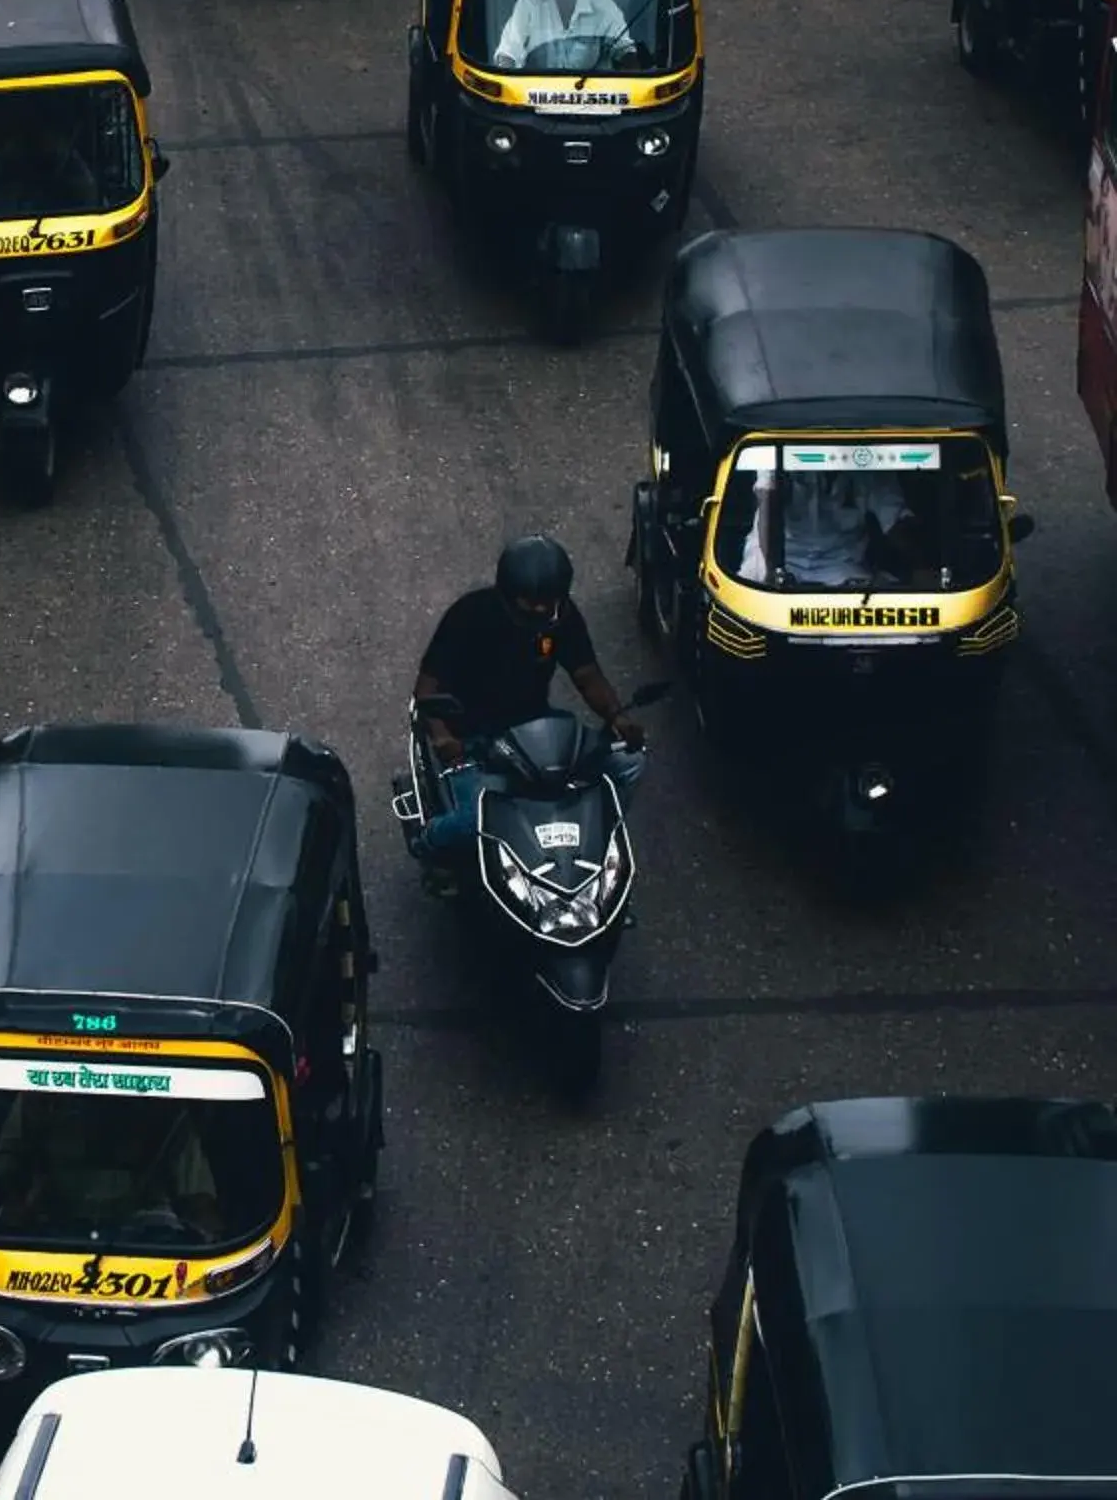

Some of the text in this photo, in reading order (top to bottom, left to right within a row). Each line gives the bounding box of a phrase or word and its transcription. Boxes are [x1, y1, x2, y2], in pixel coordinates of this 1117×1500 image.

[72, 1014, 117, 1031] 786
[26, 1070, 48, 1086] या
[78, 1066, 108, 1088] तेरा
